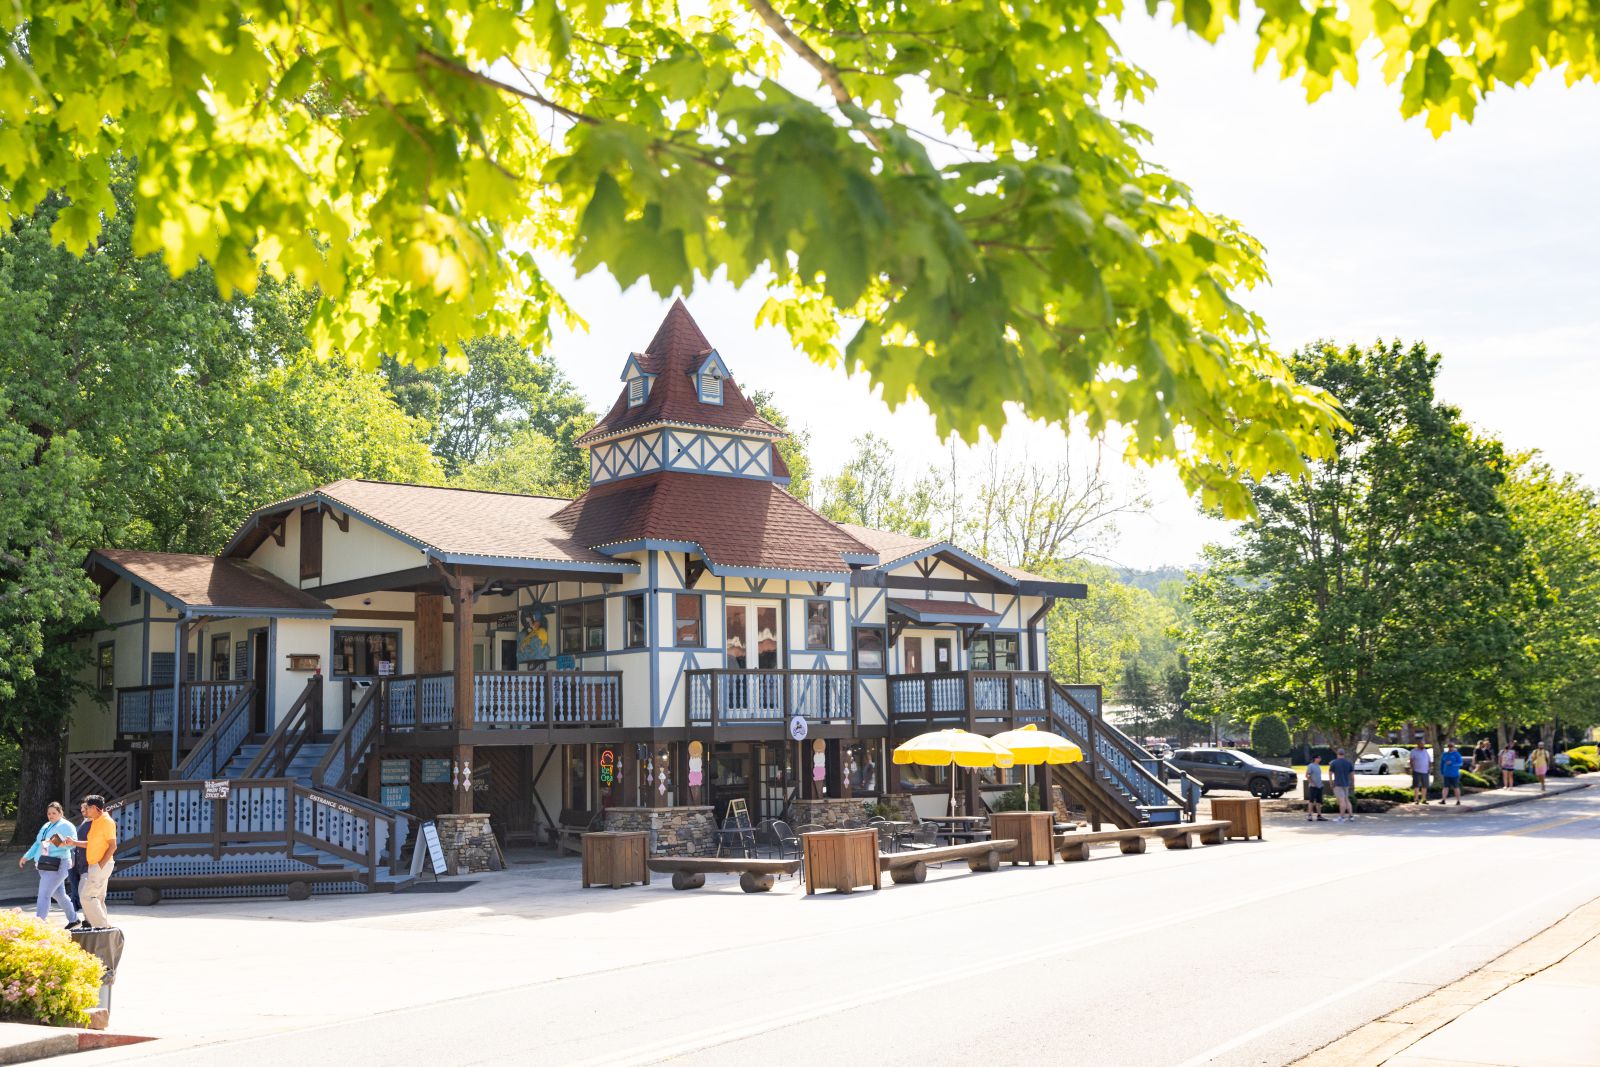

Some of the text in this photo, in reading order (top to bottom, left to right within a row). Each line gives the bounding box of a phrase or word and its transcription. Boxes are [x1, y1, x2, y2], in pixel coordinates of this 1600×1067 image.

[105, 800, 125, 812] ONLY
[309, 794, 354, 814] ENTRANCE ONLY
